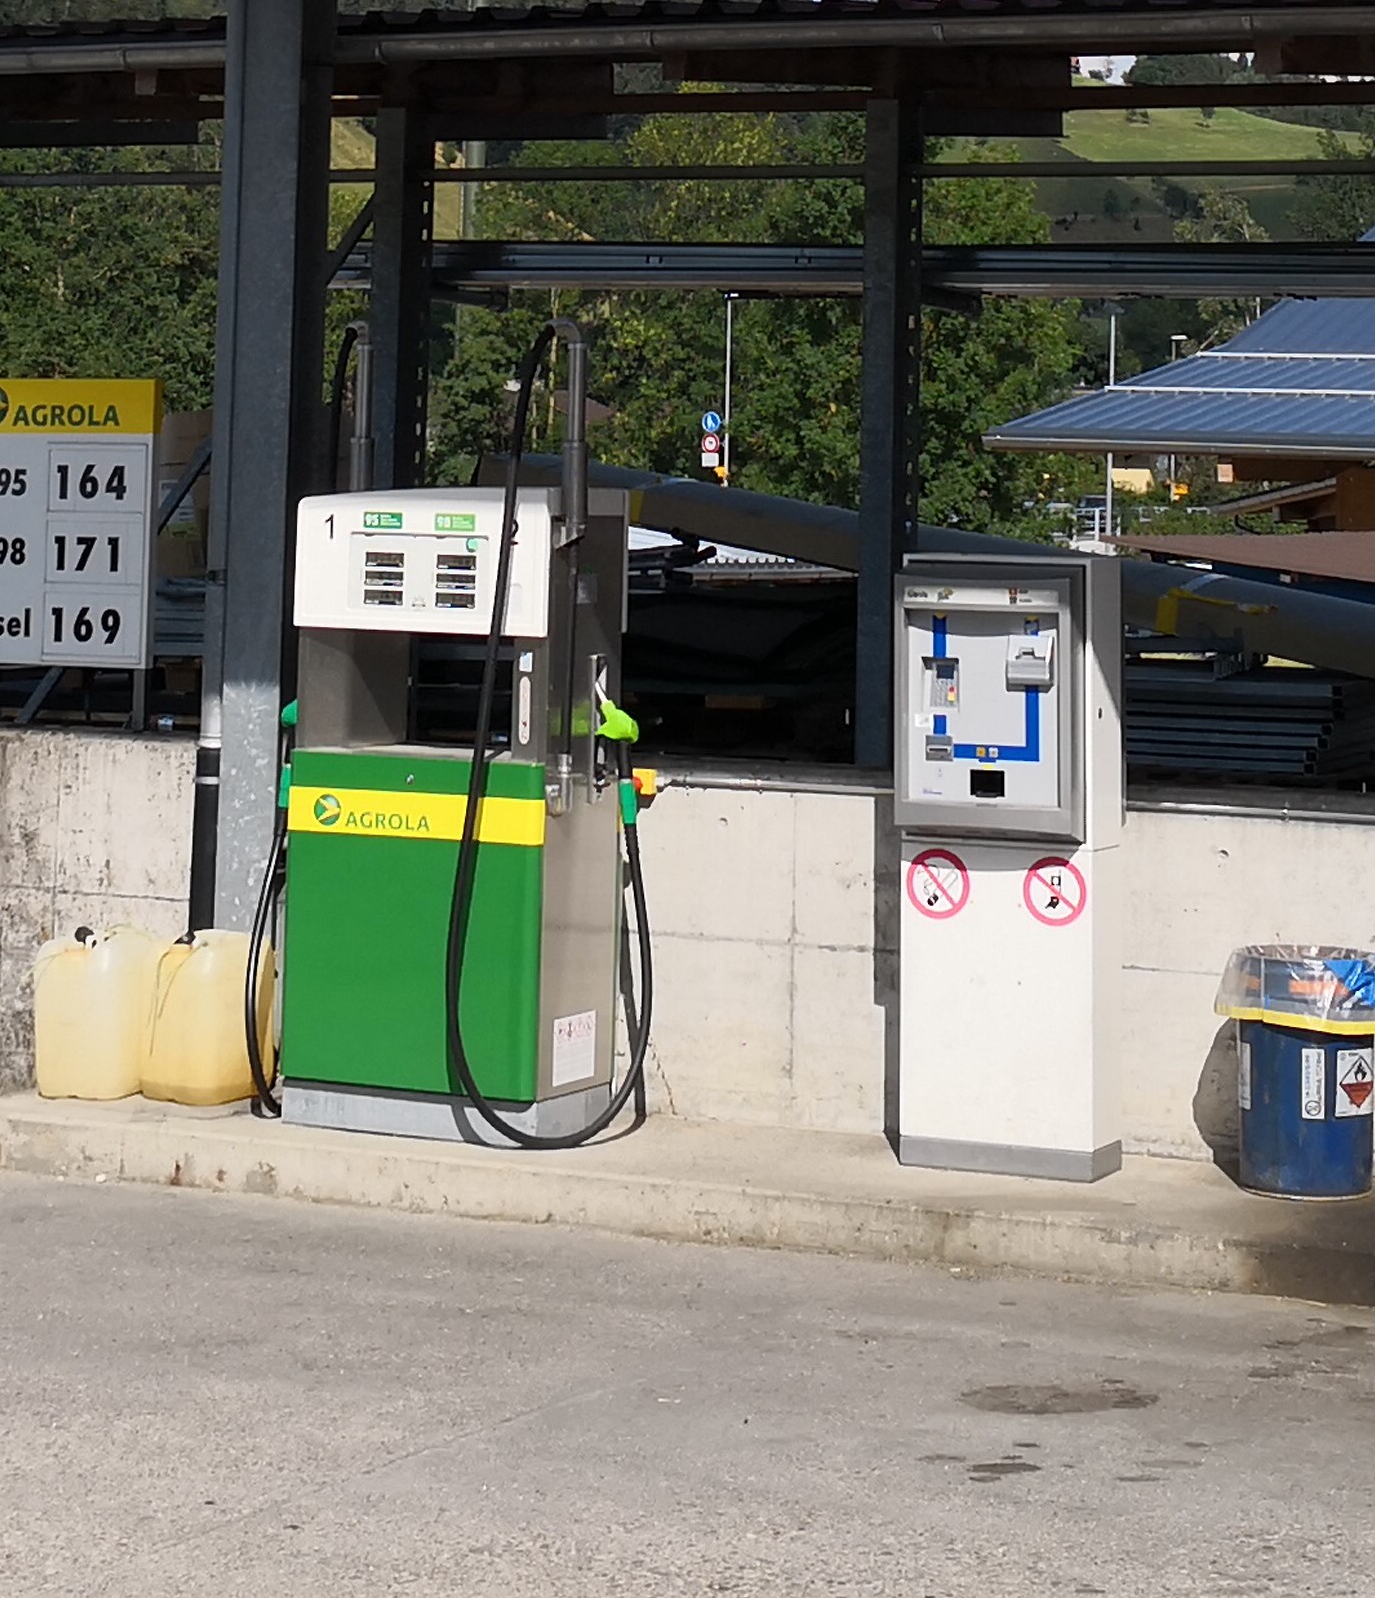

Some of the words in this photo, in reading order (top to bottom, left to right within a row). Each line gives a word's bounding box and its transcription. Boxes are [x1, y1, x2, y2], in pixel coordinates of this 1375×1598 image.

[12, 404, 120, 427] AGROLA
[57, 464, 127, 500] 164
[325, 514, 334, 539] 1
[54, 535, 120, 572] 171
[52, 607, 121, 644] 169
[345, 810, 430, 831] AGROLA
